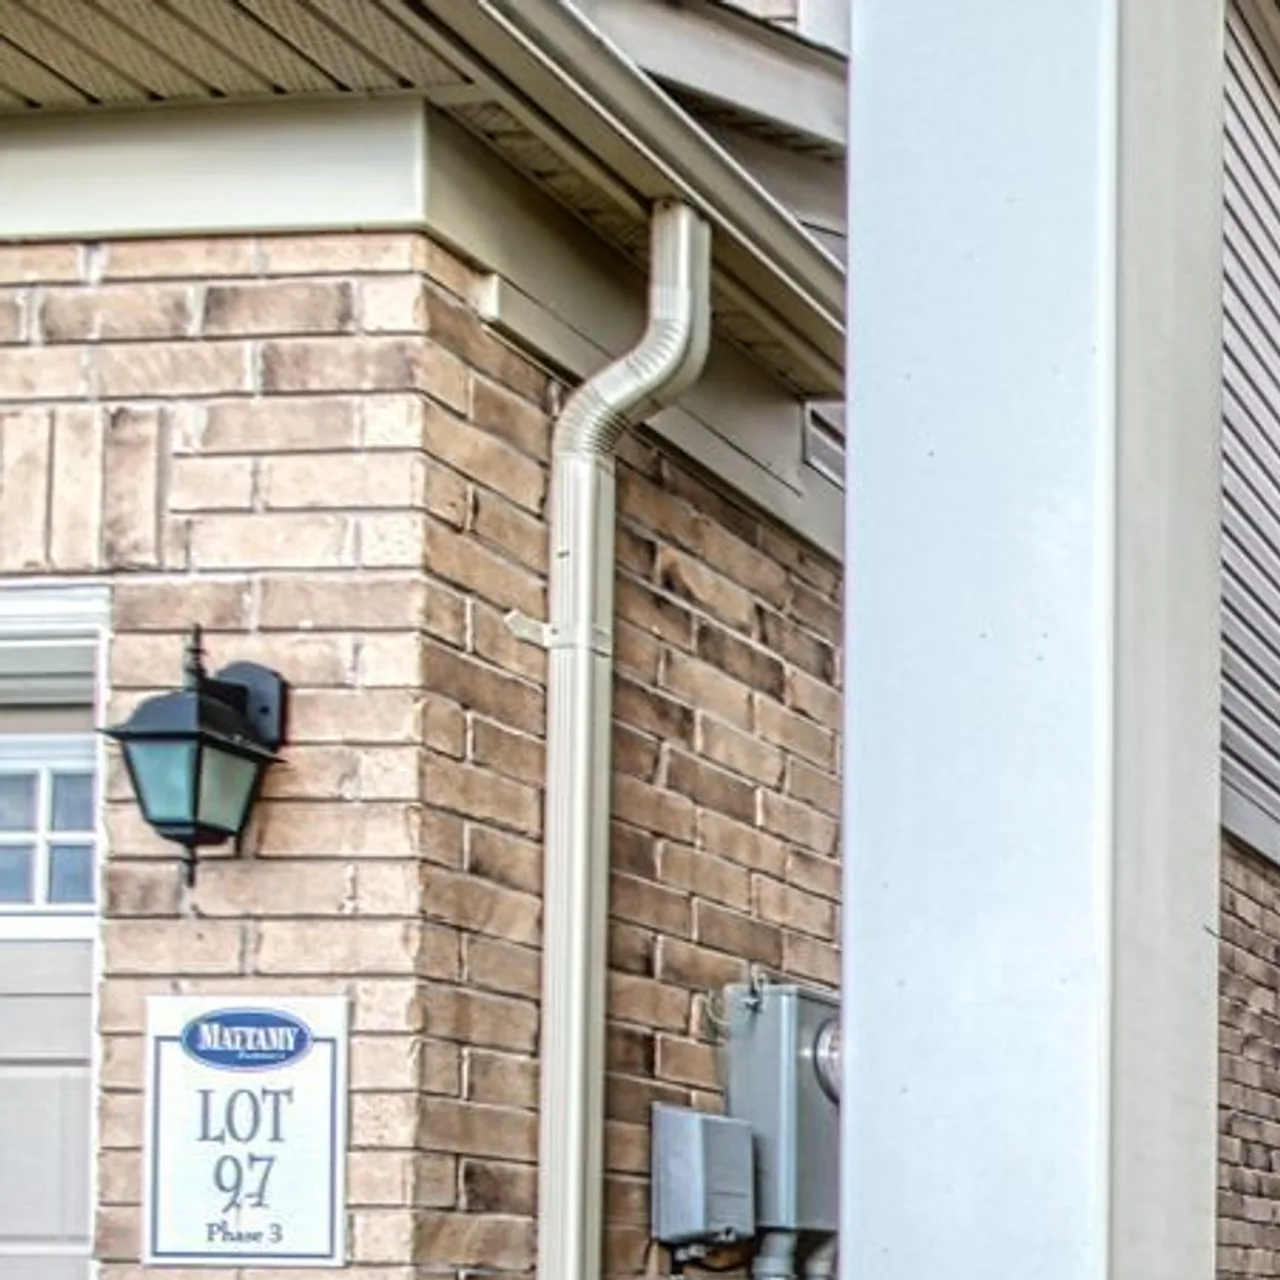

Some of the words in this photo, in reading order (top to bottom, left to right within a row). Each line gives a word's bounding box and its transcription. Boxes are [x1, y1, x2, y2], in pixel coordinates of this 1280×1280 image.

[198, 1022, 300, 1051] MATTAMY
[196, 1085, 295, 1145] LOT
[212, 1151, 277, 1214] 97
[205, 1220, 263, 1243] Phase
[267, 1222, 284, 1243] 3
